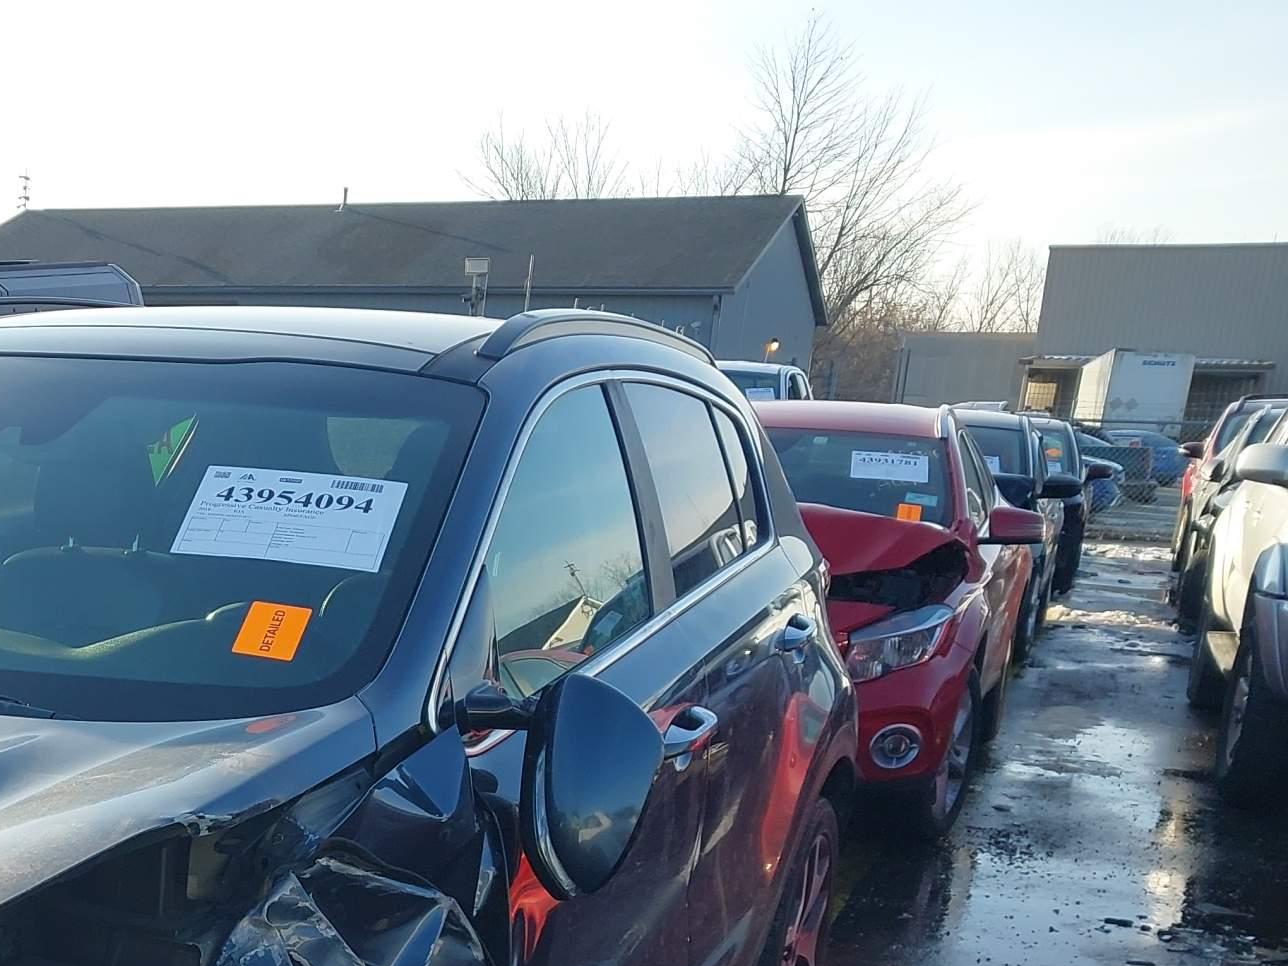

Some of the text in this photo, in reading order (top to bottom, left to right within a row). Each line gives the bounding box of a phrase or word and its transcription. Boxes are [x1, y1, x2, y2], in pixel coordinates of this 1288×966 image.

[199, 500, 325, 515] Progressive Casualty Insurance
[216, 486, 373, 514] 43954094
[259, 609, 286, 652] DETAILED
